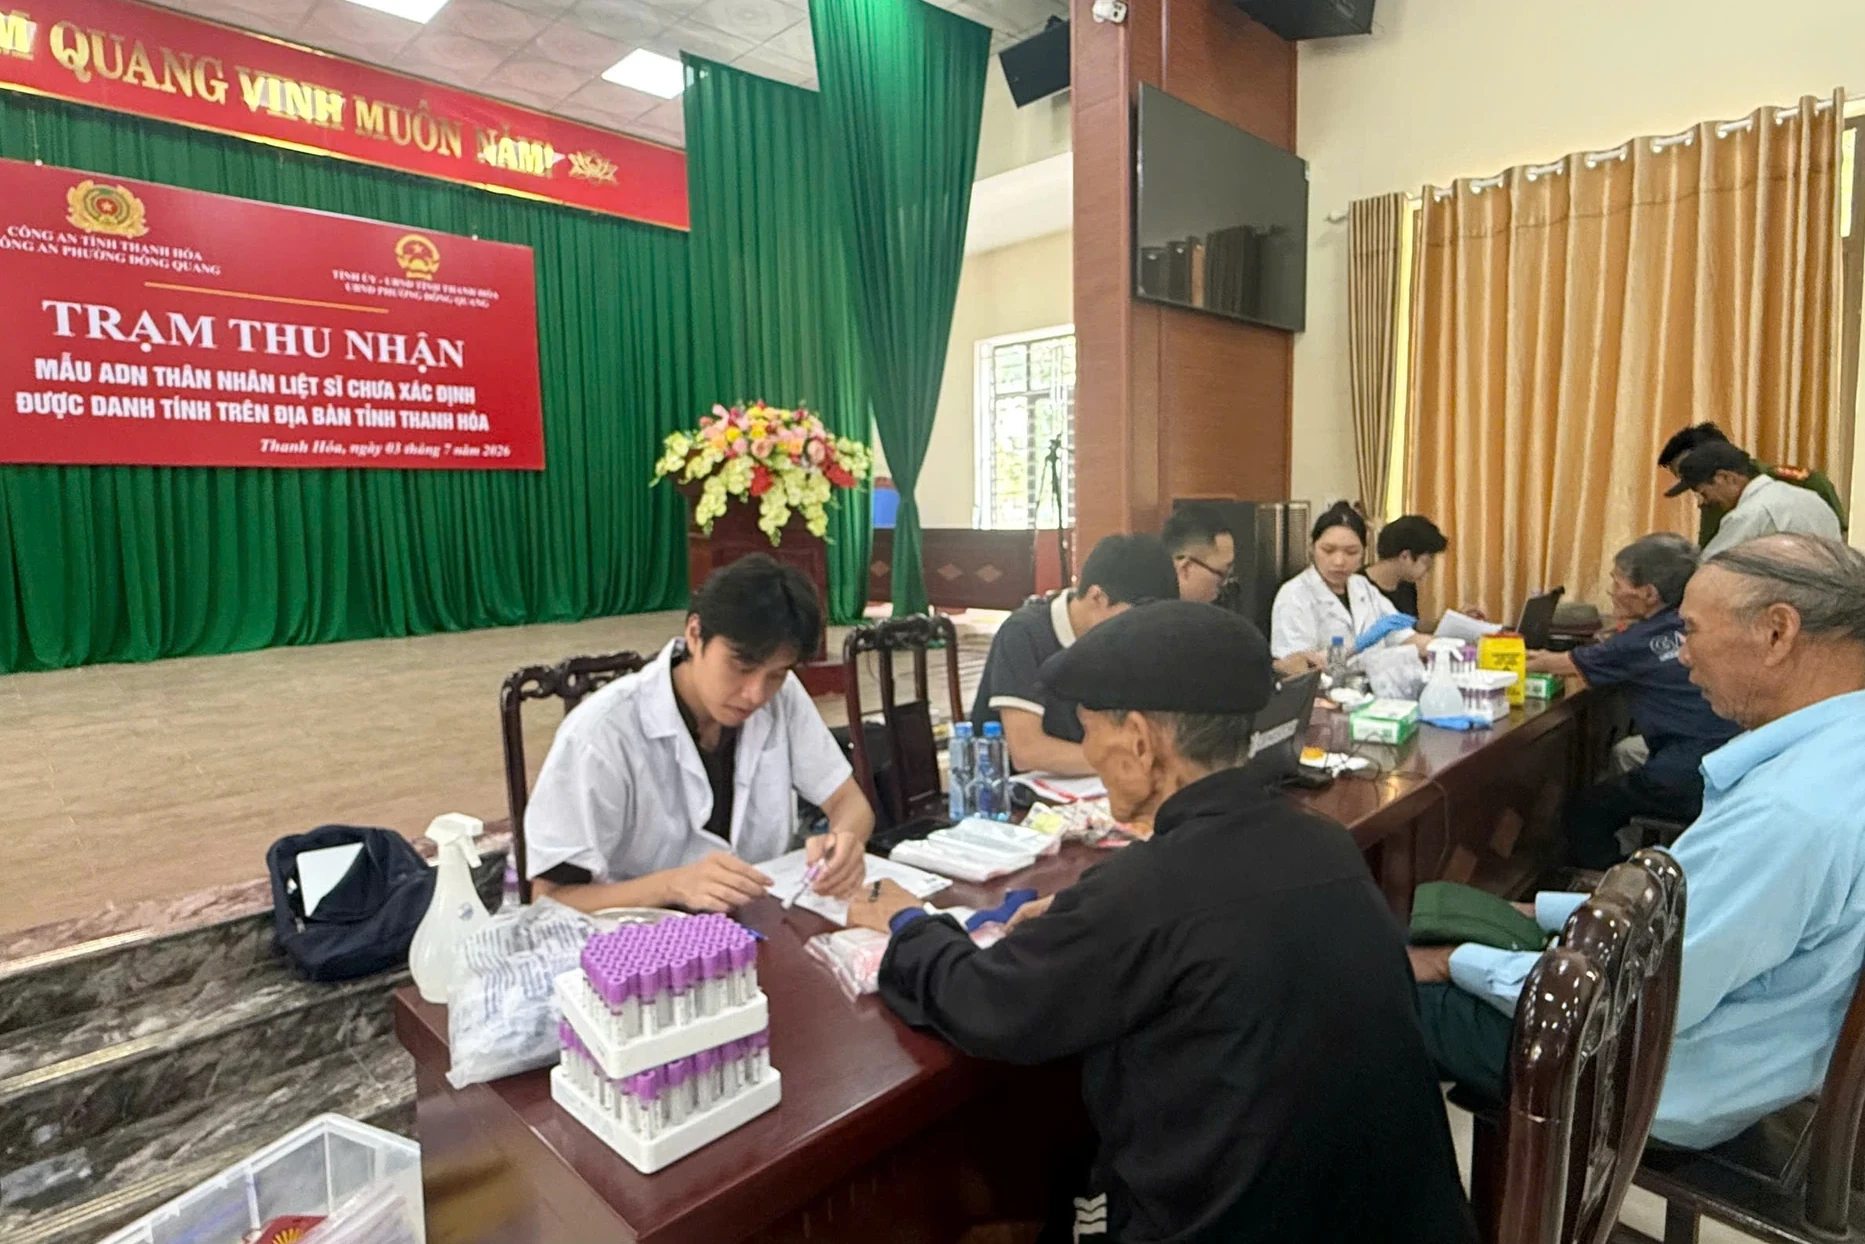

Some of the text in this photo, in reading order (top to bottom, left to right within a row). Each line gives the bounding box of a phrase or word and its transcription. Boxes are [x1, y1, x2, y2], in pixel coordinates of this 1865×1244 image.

[50, 20, 229, 105] QUANG
[234, 65, 344, 130] VINH
[353, 97, 464, 158] MUÔN
[7, 224, 53, 241] CÔNG
[56, 234, 77, 245] AN
[120, 240, 170, 257] THANH
[173, 246, 203, 261] HÓA
[37, 242, 59, 255] AN
[128, 255, 170, 270] ĐÔNG
[171, 261, 221, 276] QUANG
[42, 299, 465, 374] TRẠM THU NHẬN
[34, 351, 477, 407] MẪU ADN THÂN NHÂN LIỆT SĨ CHƯA XÁC ĐỊNH
[15, 391, 490, 432] ĐƯỢC DANH TÍNH TRÊN ĐỊA BÀN TỈNH THANH HÓA
[260, 438, 309, 454] Thanh
[312, 439, 346, 456] Hóa,
[349, 441, 383, 458] ngày
[404, 441, 440, 459] tháng
[443, 444, 451, 455] 7
[453, 445, 481, 457] năm
